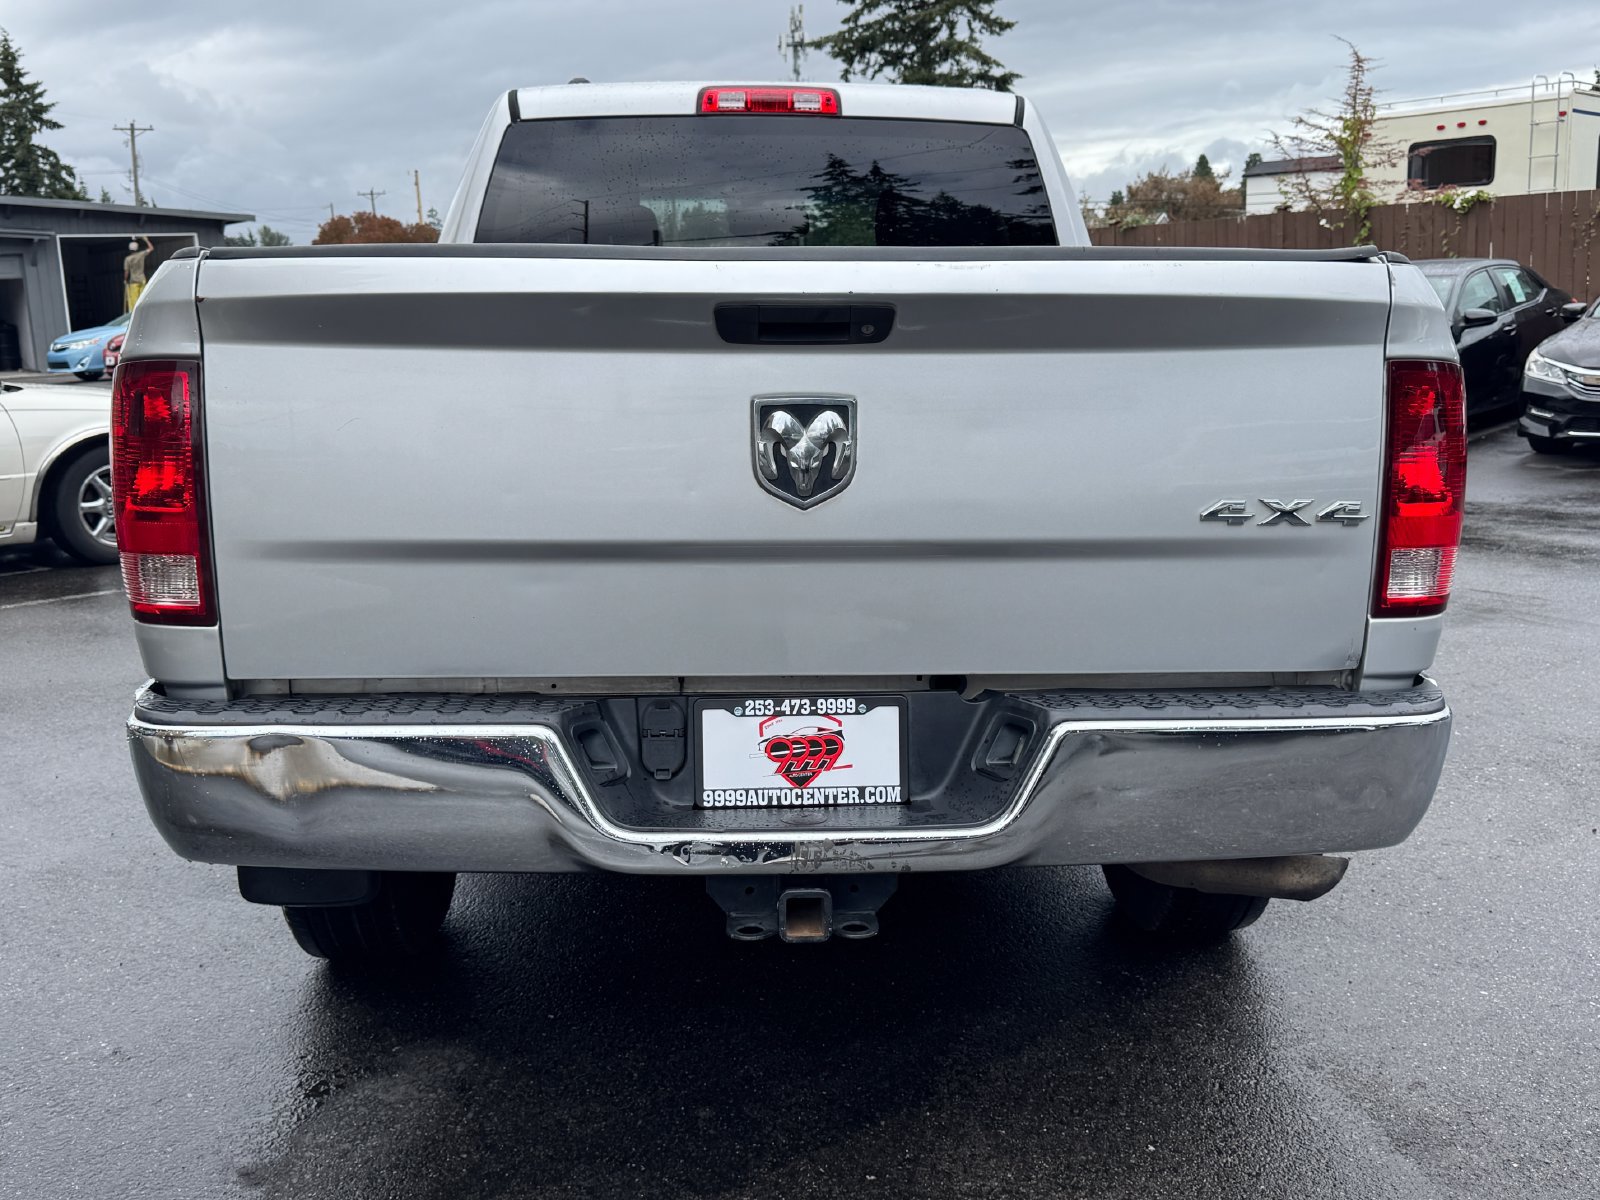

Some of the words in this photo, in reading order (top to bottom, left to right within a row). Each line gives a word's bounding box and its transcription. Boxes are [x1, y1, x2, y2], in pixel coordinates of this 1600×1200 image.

[1200, 499, 1370, 526] 4X4
[744, 698, 856, 716] 253-473-9999
[702, 787, 901, 807] 9999AUTOCENTER.COM
